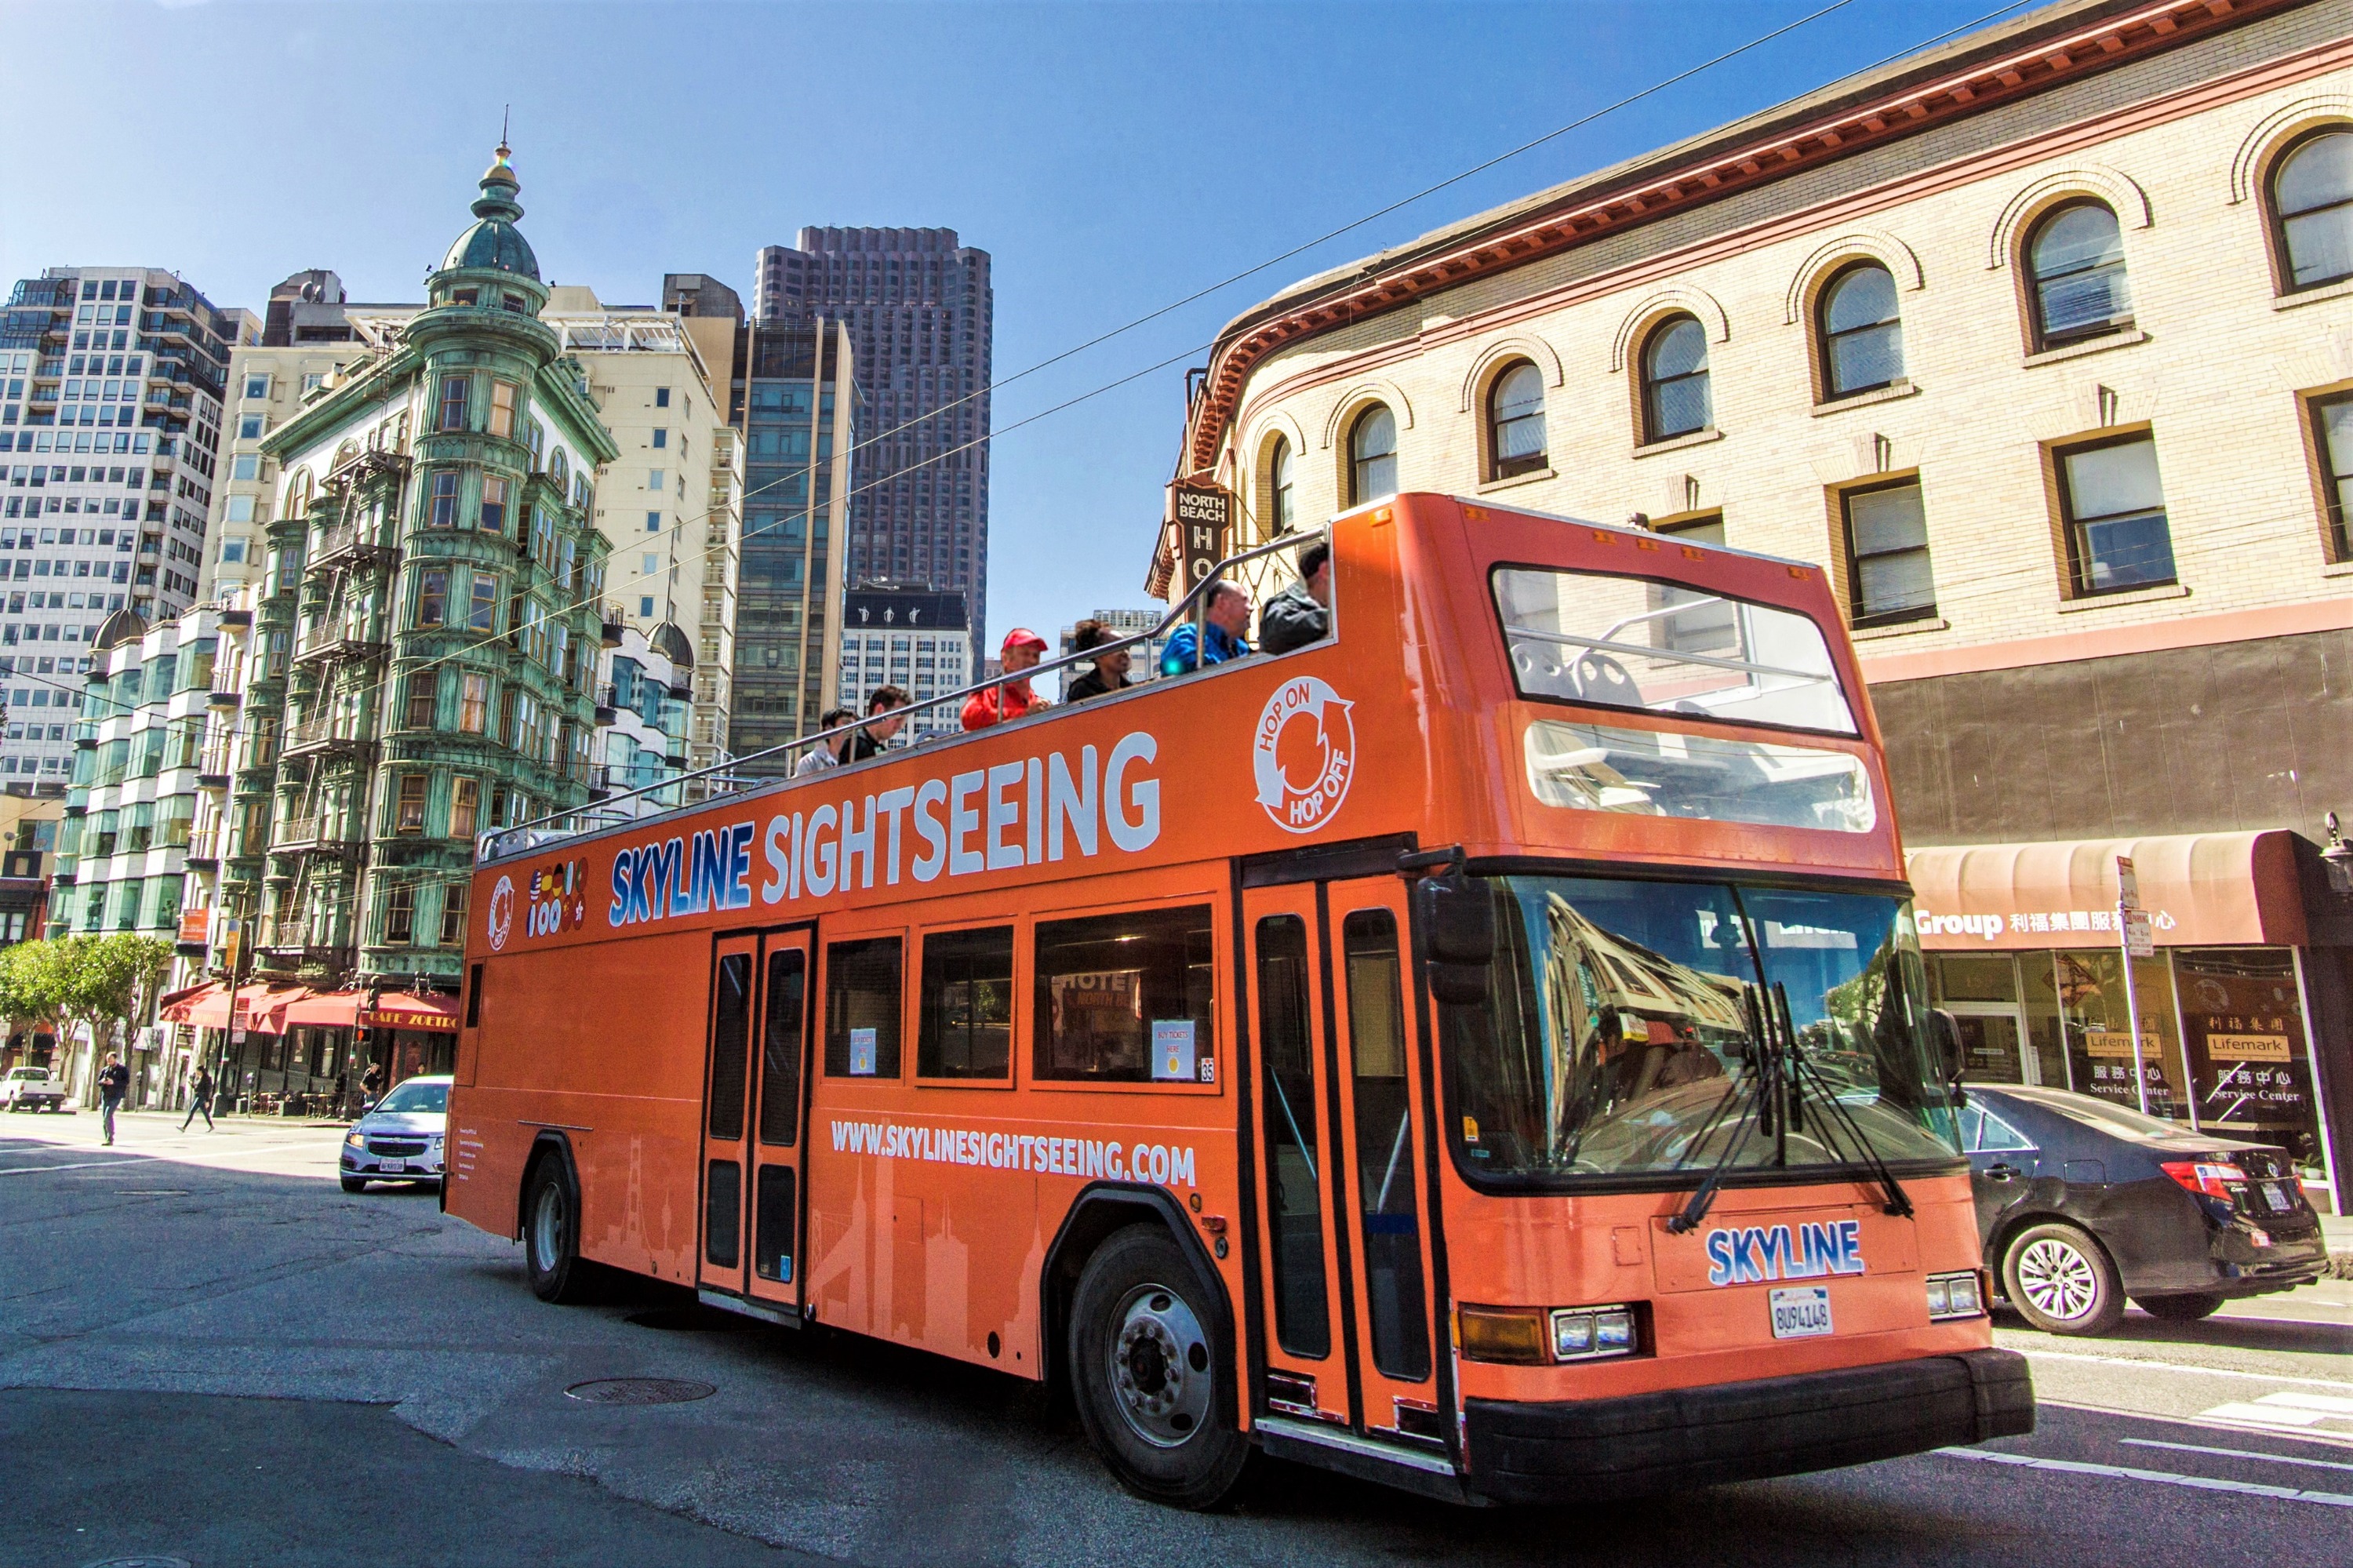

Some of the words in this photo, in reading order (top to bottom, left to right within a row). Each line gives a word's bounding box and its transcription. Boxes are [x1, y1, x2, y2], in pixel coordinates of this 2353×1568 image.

[1179, 493, 1225, 510] NORTH
[1179, 505, 1225, 522] BEACH
[1260, 701, 1282, 752] HOP
[1286, 682, 1310, 708] ON
[1290, 791, 1324, 824] HOP
[1323, 748, 1349, 798] OFF
[609, 820, 755, 928] SKYLINE
[762, 730, 1160, 905] SIGHTSEEING
[1913, 909, 2004, 941] Group
[2009, 909, 2177, 933] 利福集團服心
[369, 1011, 402, 1024] CAFE
[2090, 1035, 2155, 1048] Lifemrk
[2213, 1038, 2283, 1051] Lifemark
[1203, 1064, 1213, 1080] 35
[2090, 1082, 2129, 1095] Service
[2131, 1084, 2169, 1096] Cnter
[2213, 1089, 2256, 1100] Service
[2258, 1090, 2300, 1102] Center
[831, 1120, 1196, 1187] WWW.SKYLINESIGHTSEEING.COM
[1706, 1220, 1866, 1286] SKYLINE
